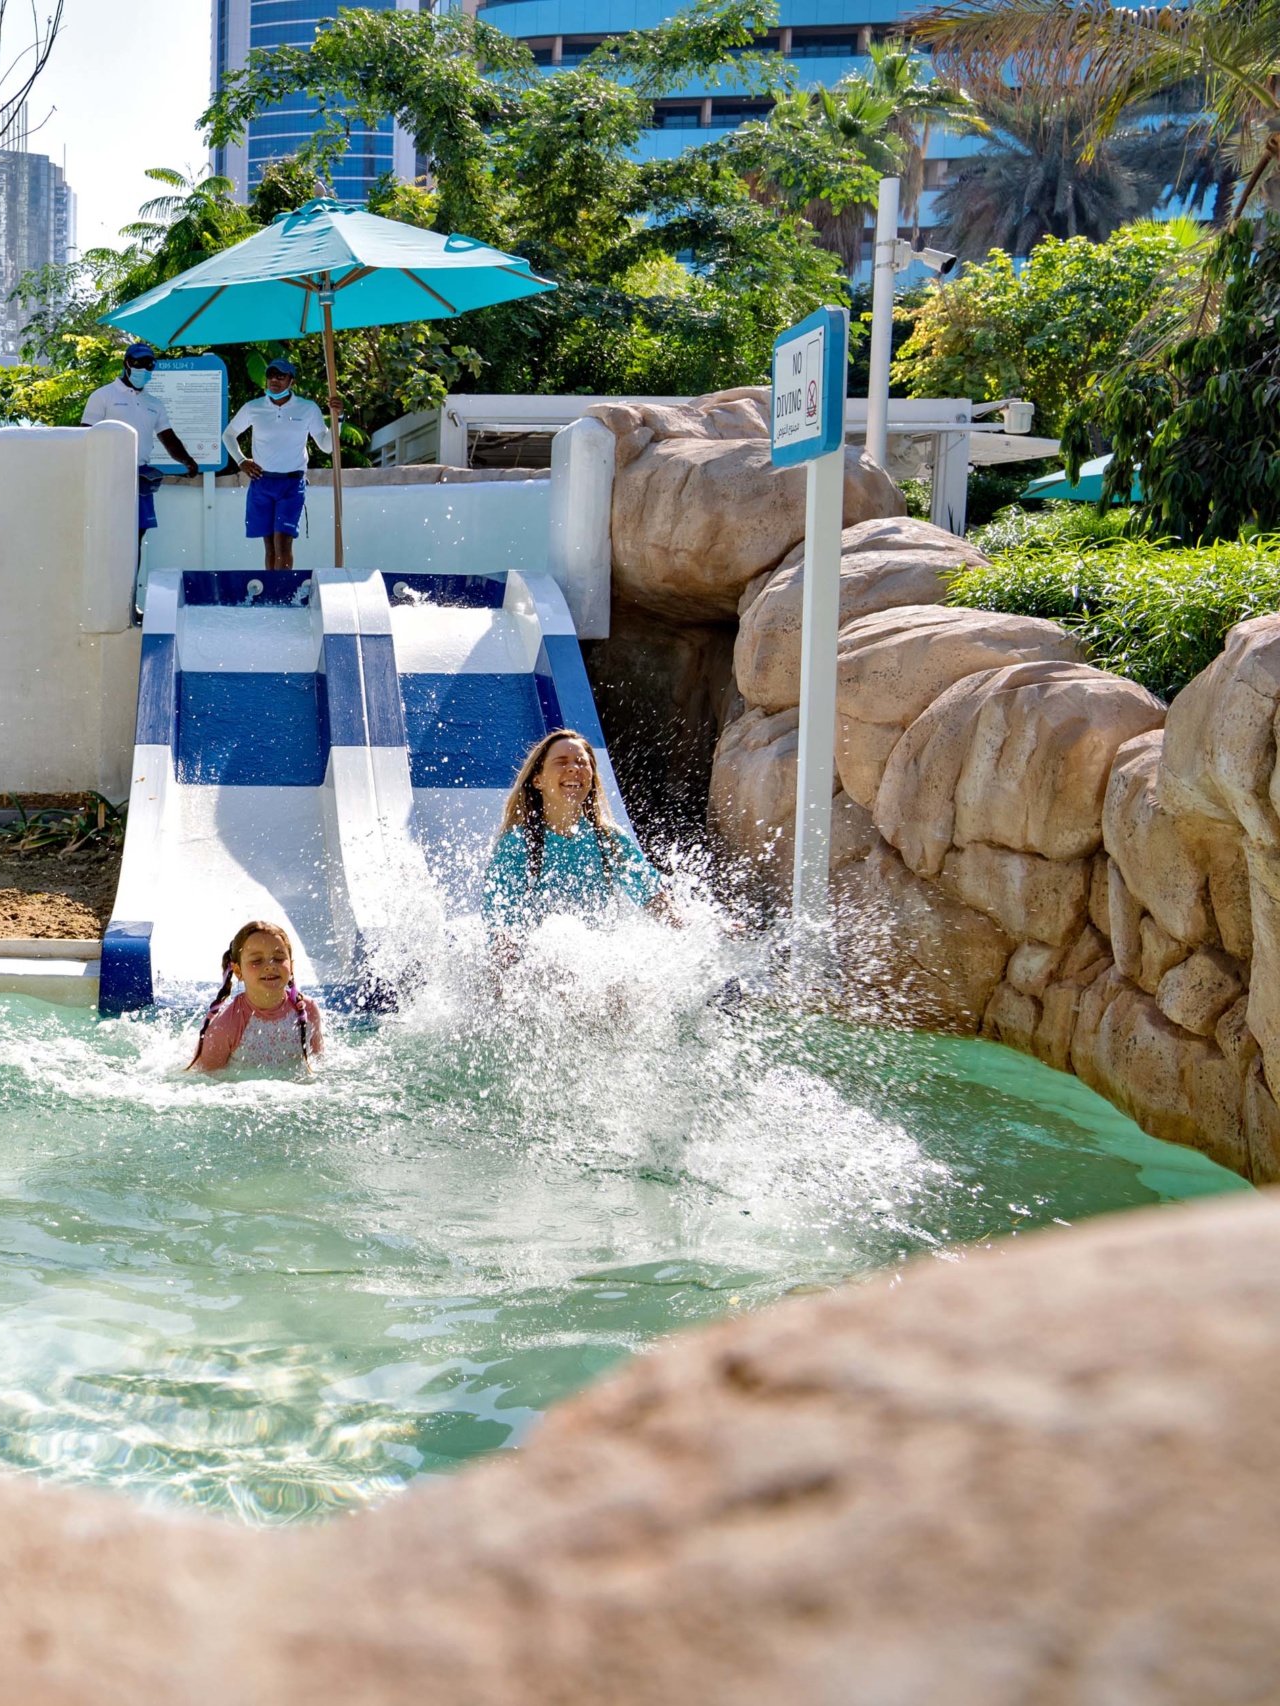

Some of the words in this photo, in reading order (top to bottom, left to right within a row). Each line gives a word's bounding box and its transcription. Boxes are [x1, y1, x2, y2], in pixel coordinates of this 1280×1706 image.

[158, 362, 171, 370] KIDS
[172, 362, 189, 370] SLIDE
[190, 362, 195, 370] 2
[792, 351, 803, 377] NO
[776, 388, 802, 419] DIVING
